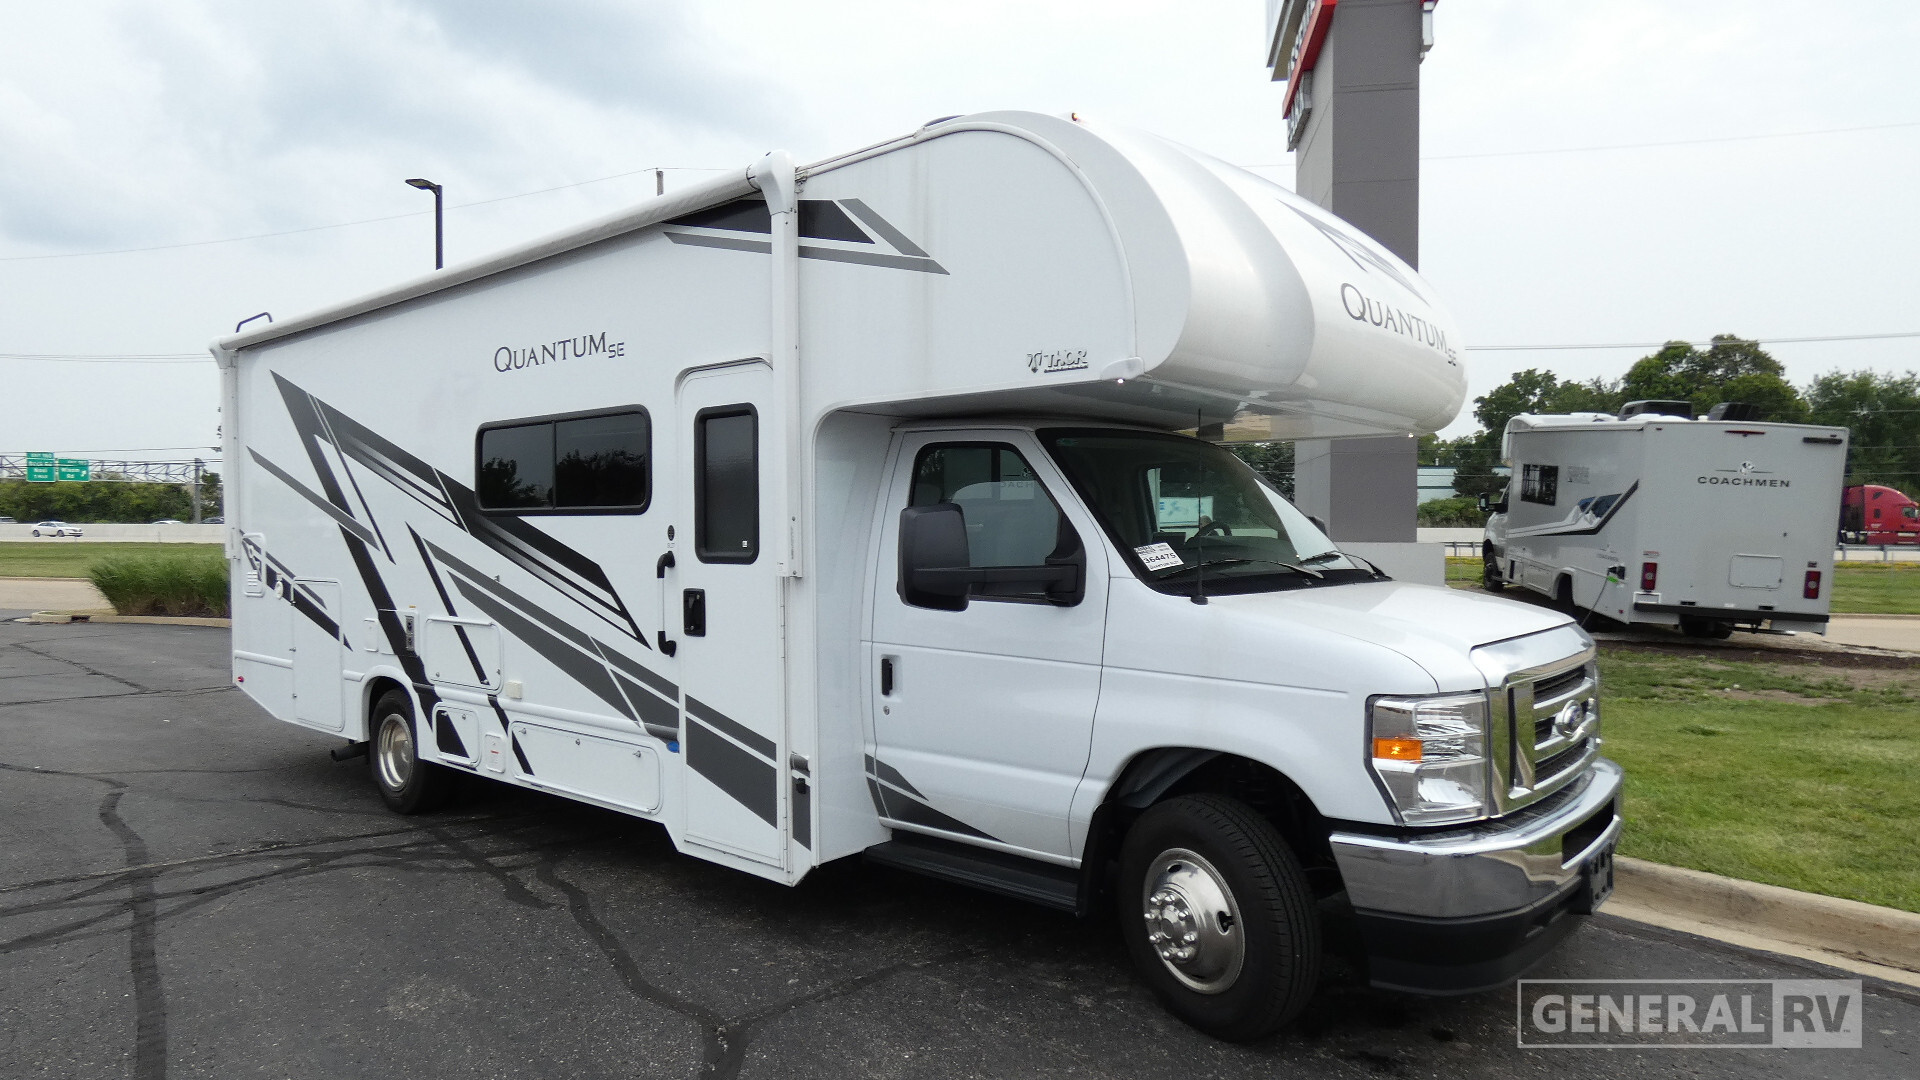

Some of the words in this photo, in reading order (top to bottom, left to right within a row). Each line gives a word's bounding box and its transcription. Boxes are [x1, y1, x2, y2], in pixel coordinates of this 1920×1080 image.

[1340, 282, 1448, 354] QUANTUM
[494, 331, 606, 372] QUANTUM
[1697, 476, 1790, 488] COACHMEN
[1143, 552, 1177, 564] 364475
